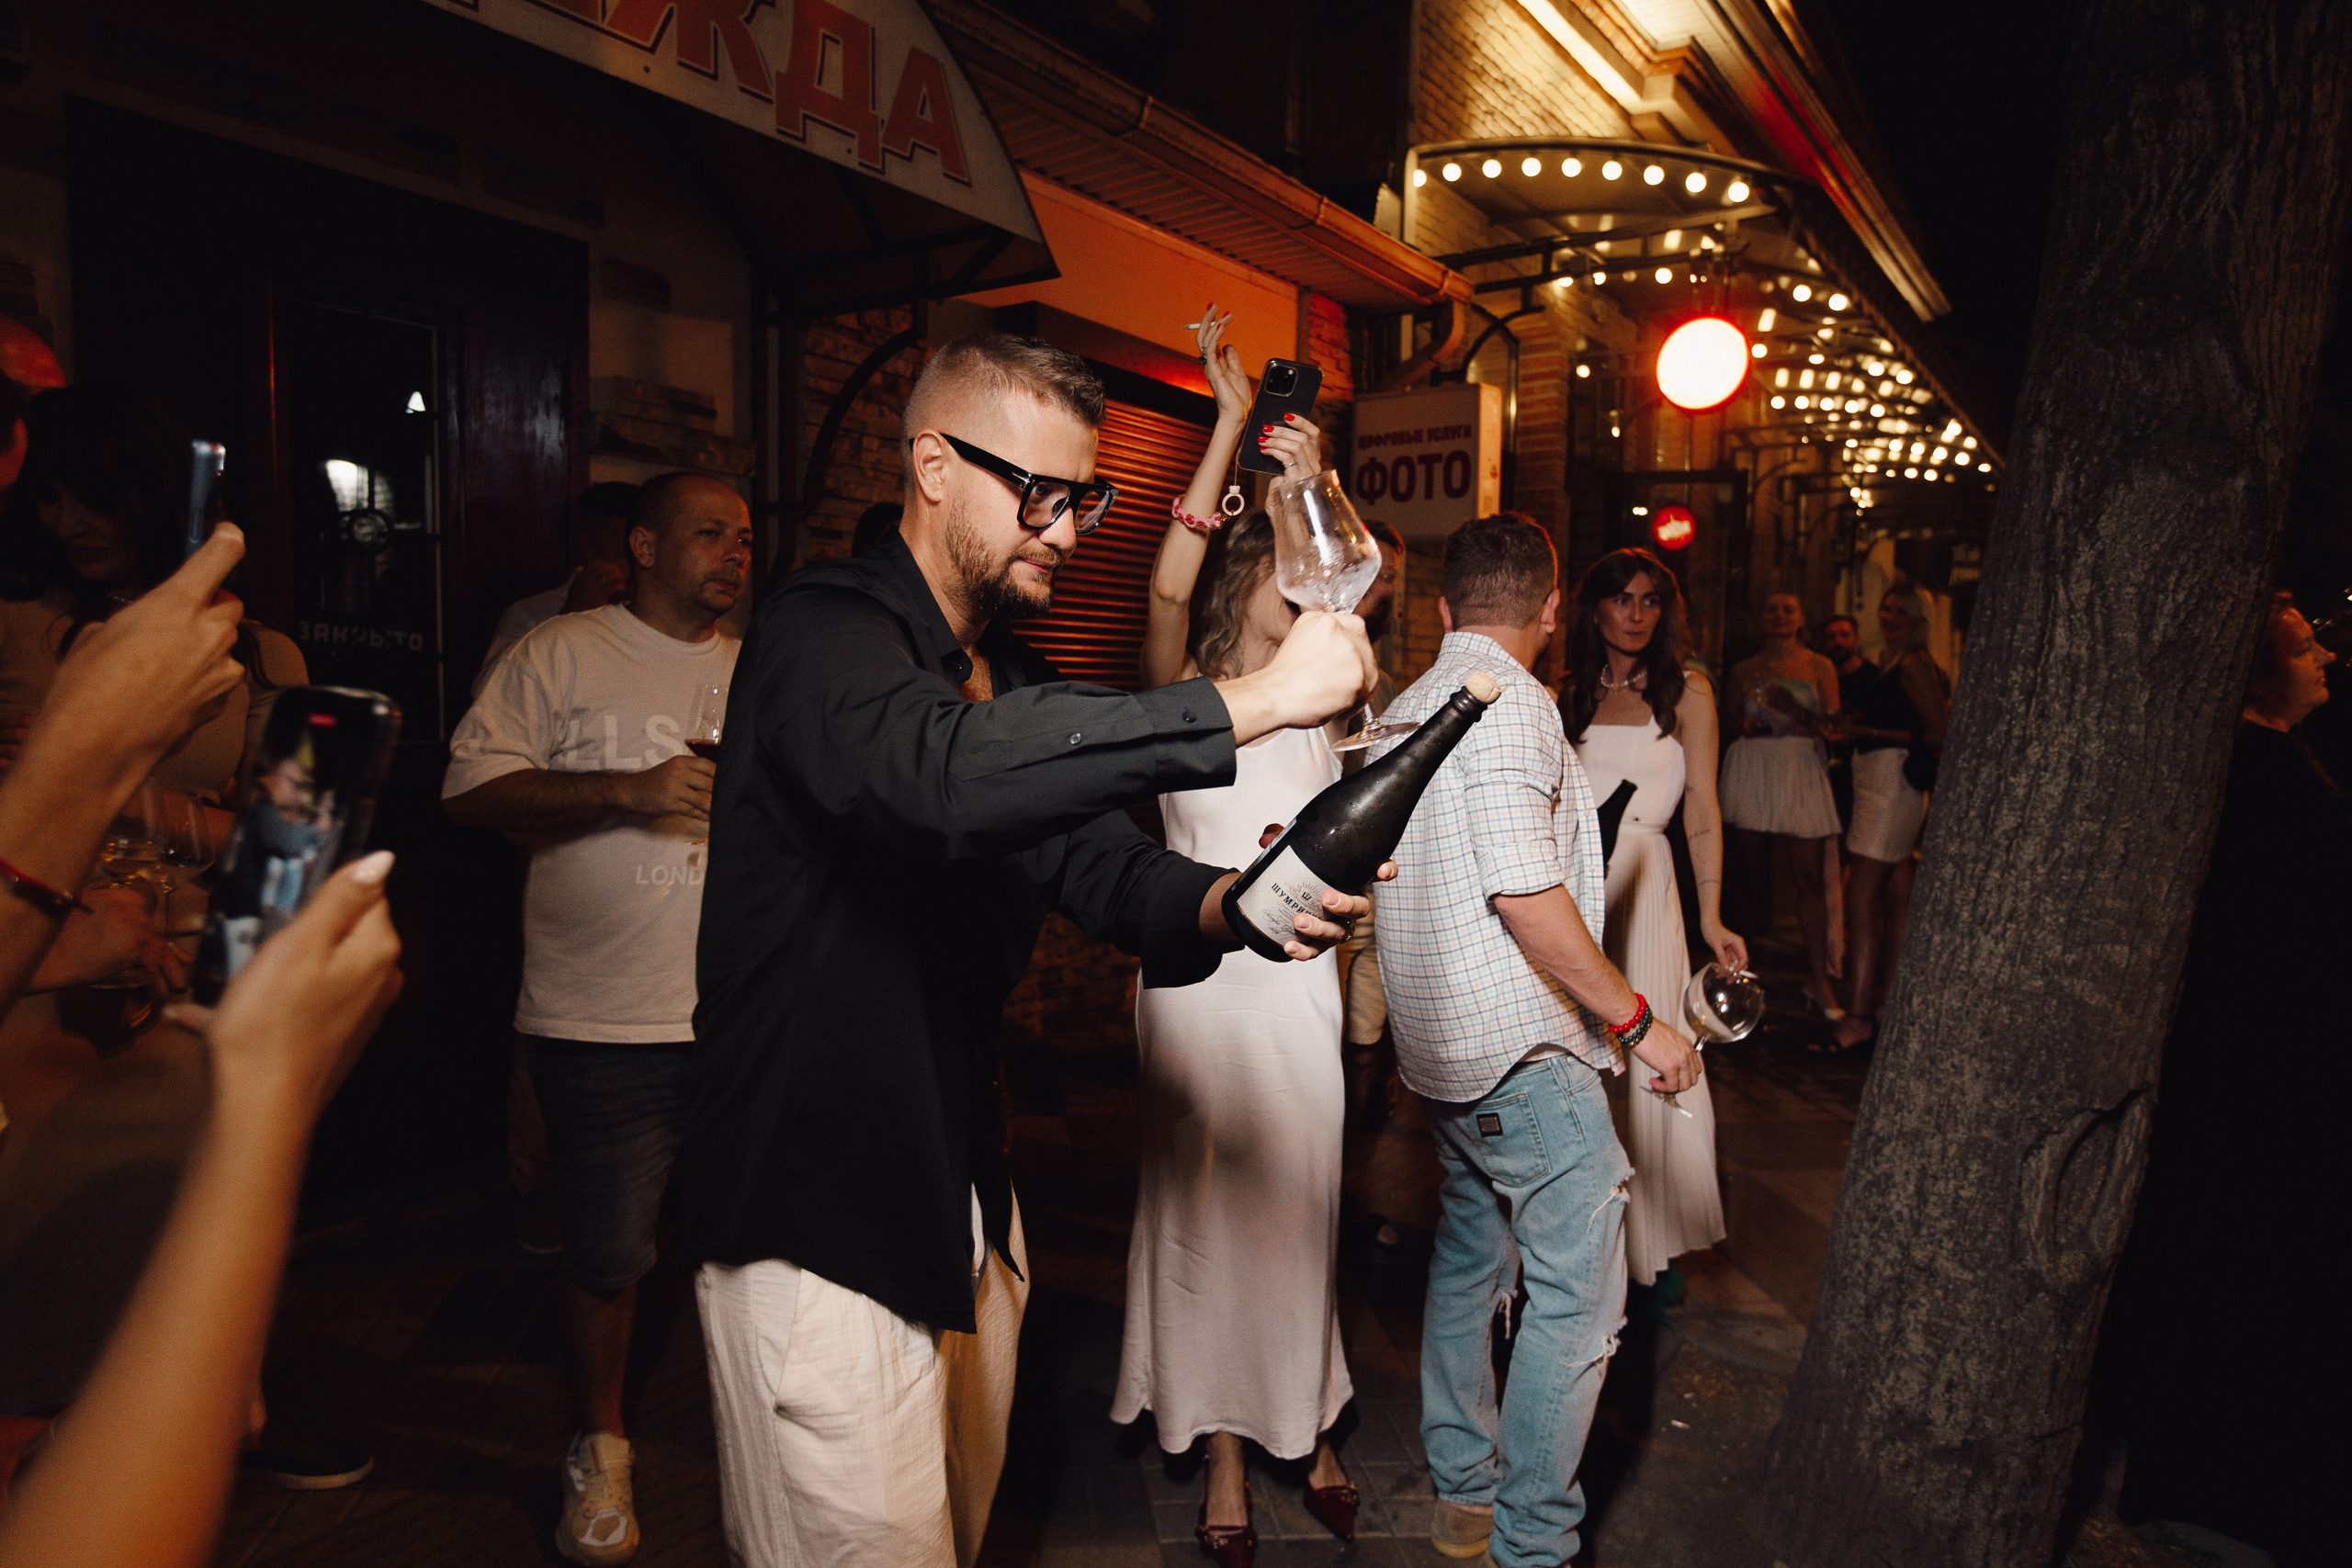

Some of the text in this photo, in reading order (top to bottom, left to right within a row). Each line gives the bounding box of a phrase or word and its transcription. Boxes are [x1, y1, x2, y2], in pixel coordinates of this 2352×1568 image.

[524, 0, 972, 187] ЖДА
[1356, 449, 1470, 505] ФОТО
[1271, 882, 1321, 919] ШУМРИ
